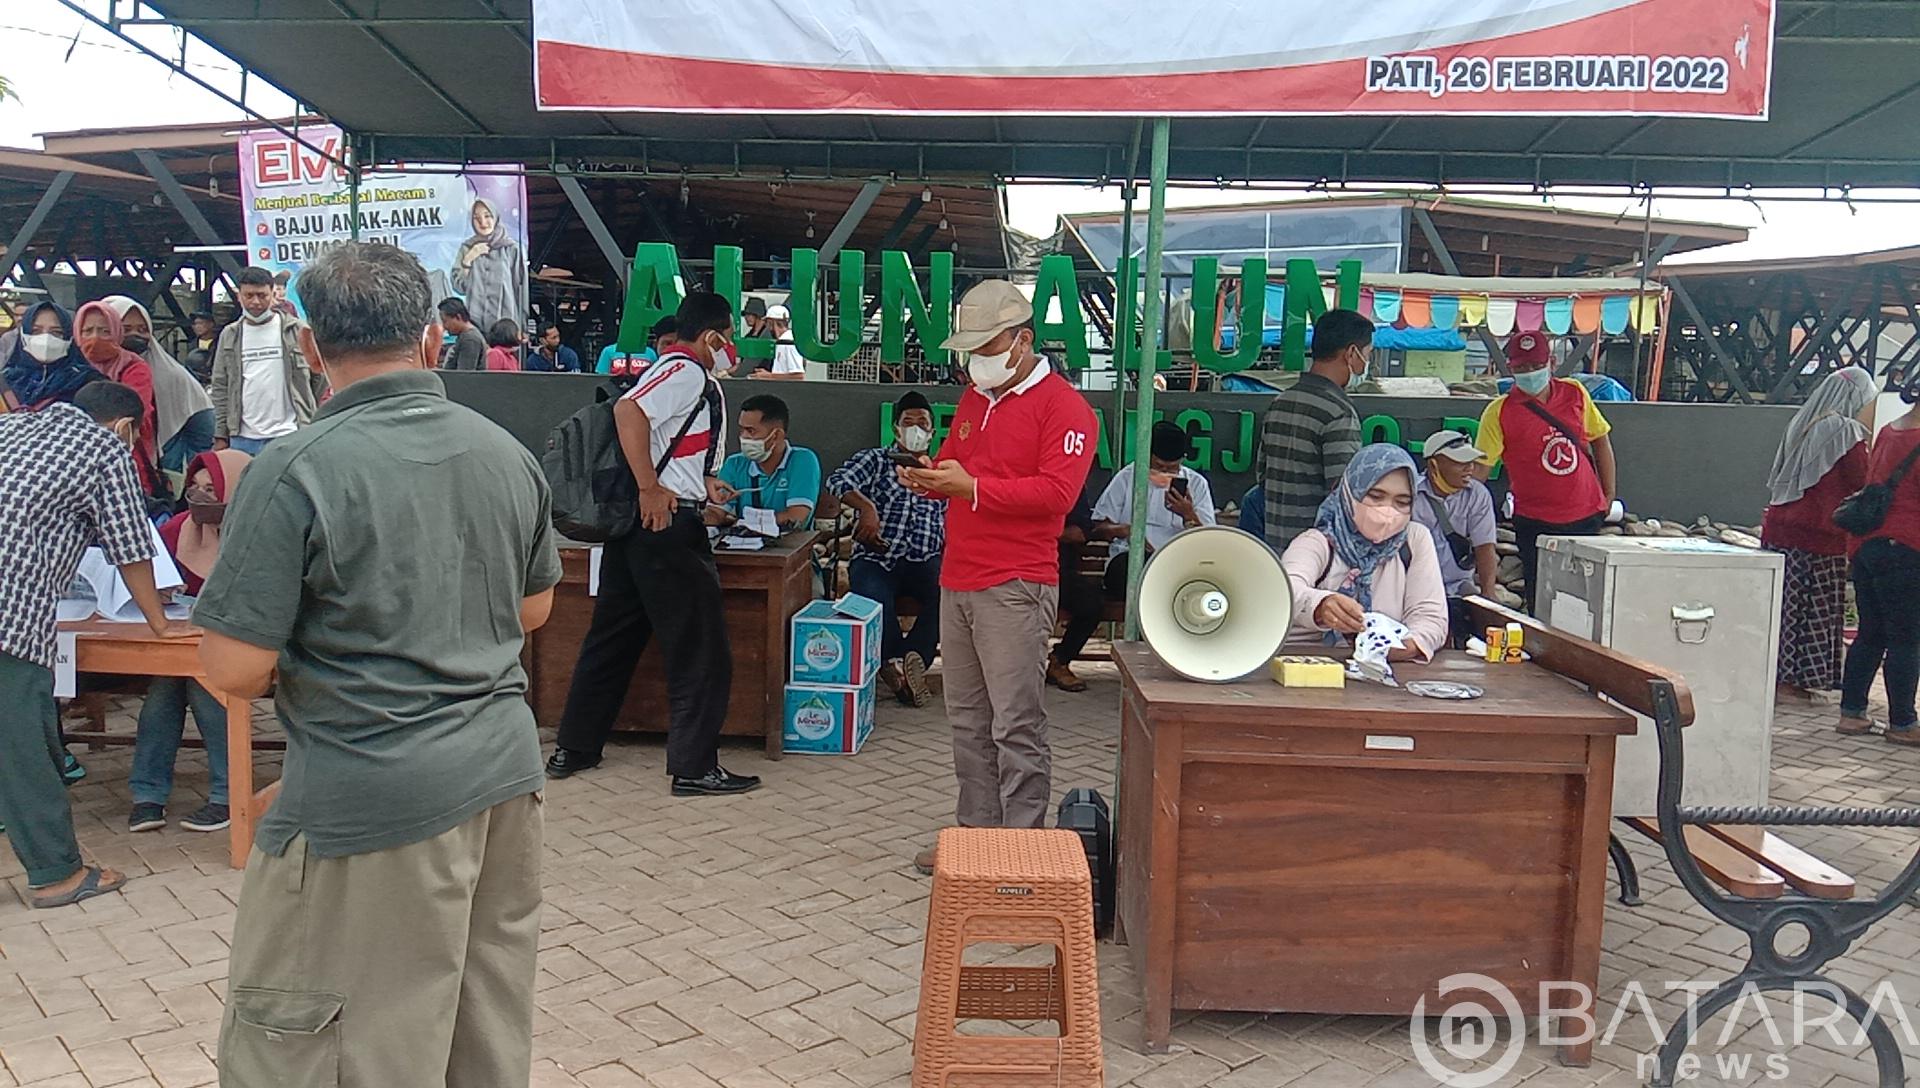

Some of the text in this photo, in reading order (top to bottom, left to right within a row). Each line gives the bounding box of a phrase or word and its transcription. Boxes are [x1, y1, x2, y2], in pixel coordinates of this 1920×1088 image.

[1368, 60, 1725, 94] PATI, 26 FEBRUARI 2022
[254, 196, 308, 212] Menjual
[312, 193, 371, 207] Berbaai
[375, 188, 426, 202] Macam
[275, 215, 324, 237] BAJU
[617, 242, 954, 365] ALUN
[1063, 429, 1086, 456] 05
